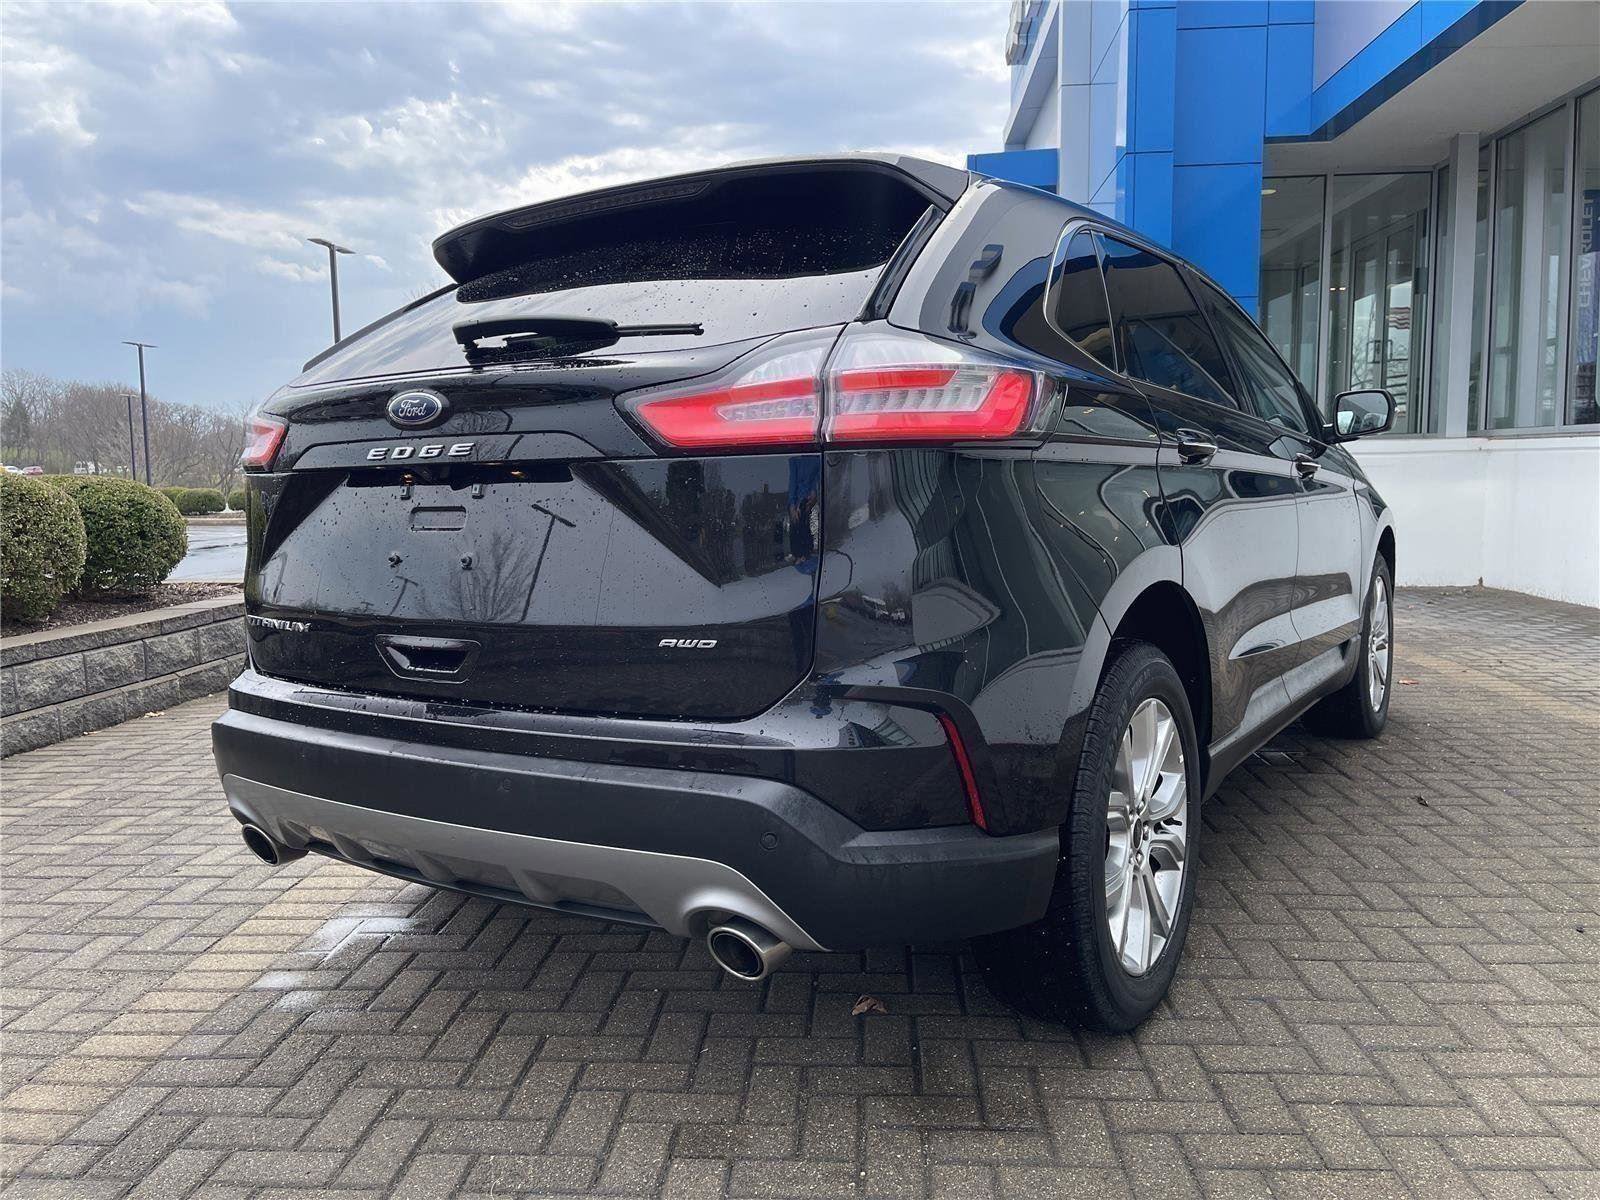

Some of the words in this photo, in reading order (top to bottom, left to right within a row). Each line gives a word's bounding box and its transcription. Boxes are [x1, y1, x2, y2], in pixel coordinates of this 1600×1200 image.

[398, 399, 427, 418] Ford
[366, 442, 475, 460] EDGE
[658, 638, 718, 649] AWD
